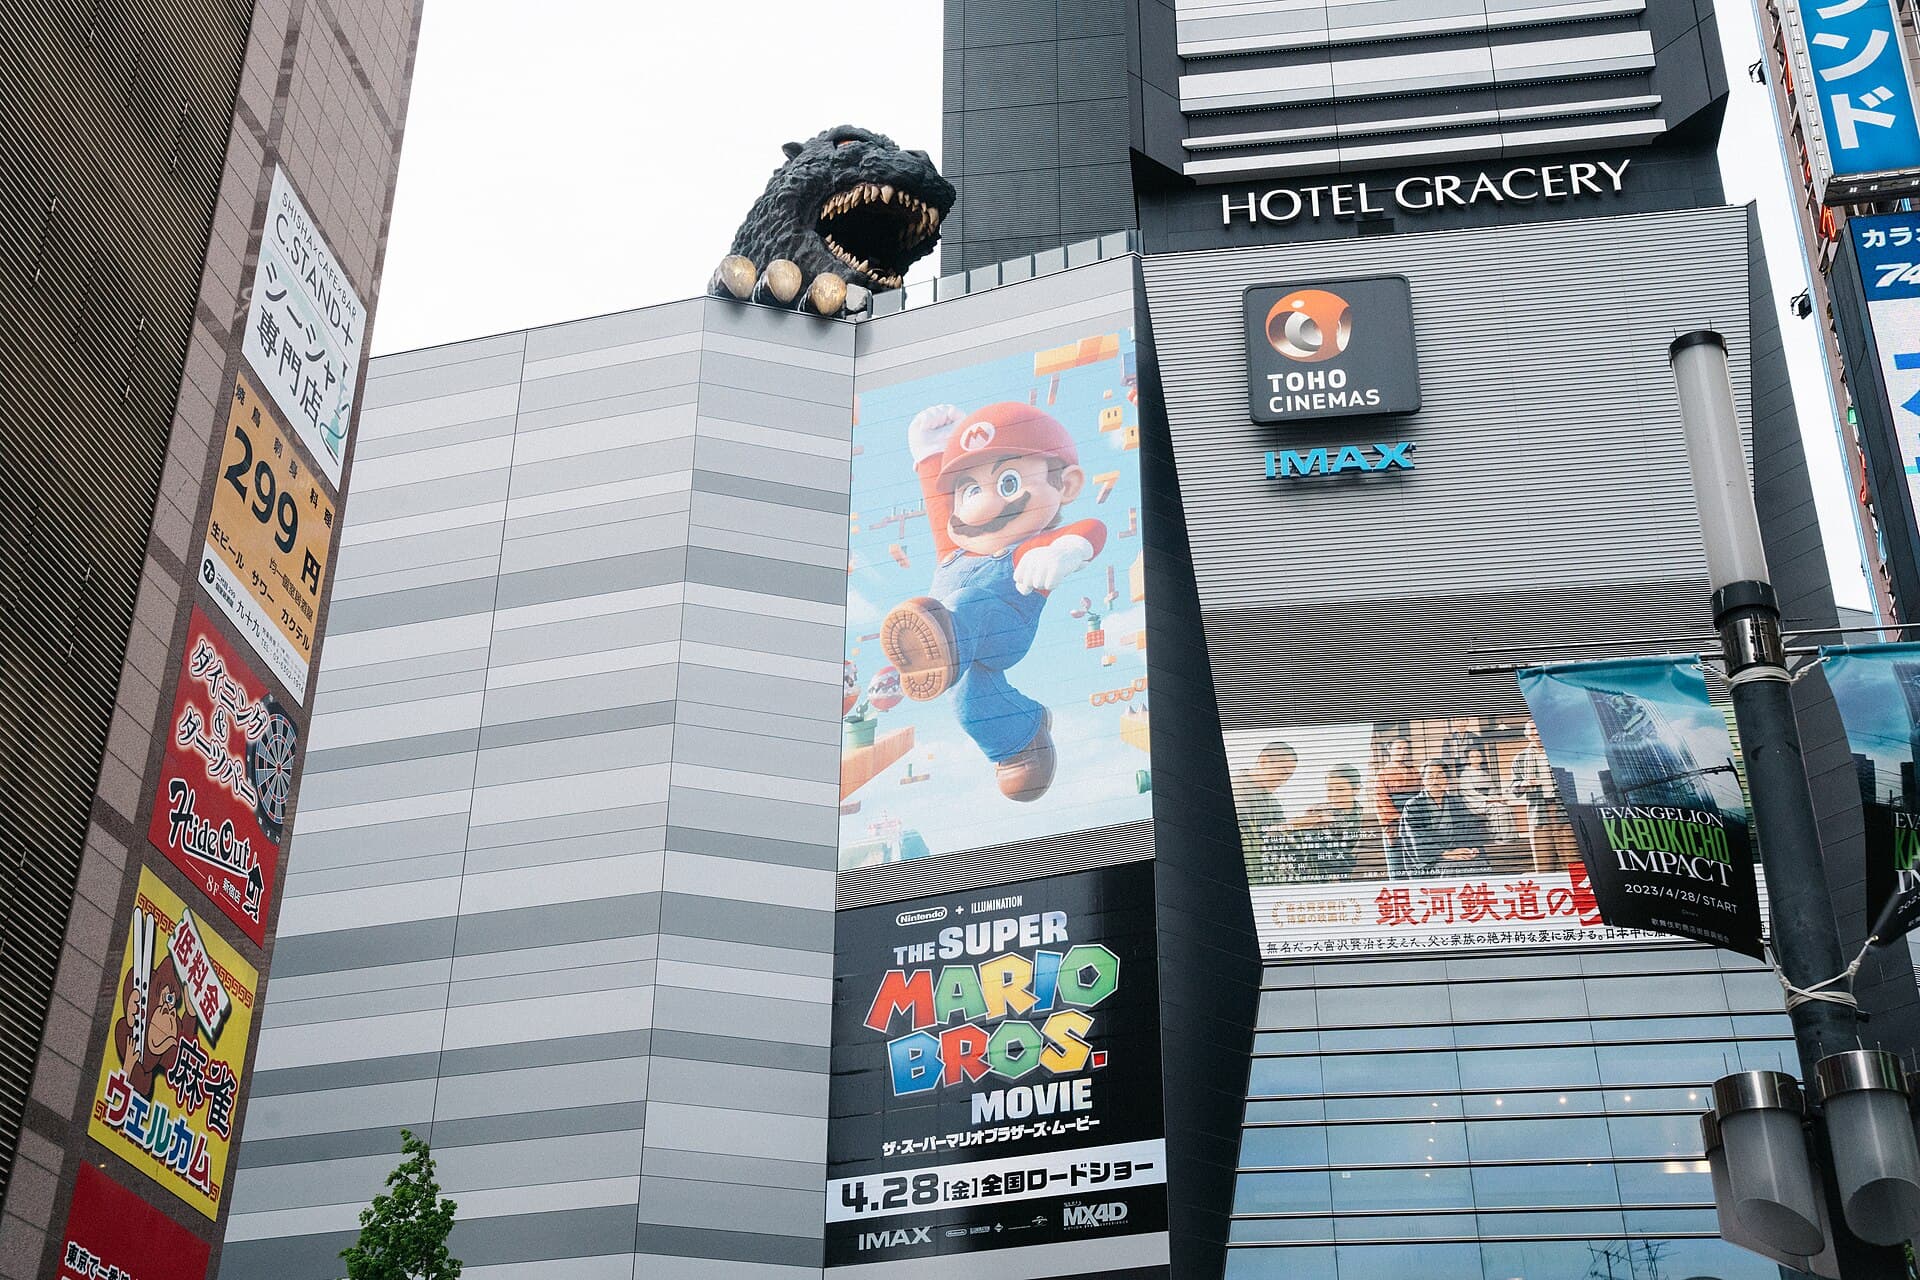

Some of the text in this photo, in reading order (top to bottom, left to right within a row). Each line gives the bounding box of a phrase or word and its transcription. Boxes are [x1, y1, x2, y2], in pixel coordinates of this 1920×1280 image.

[1222, 159, 1631, 225] HOTEL GRACERY
[1862, 226, 1920, 249] カラ
[265, 262, 335, 390] シーシャ
[256, 304, 323, 428] 専門店
[1267, 369, 1347, 393] TOHO
[1269, 389, 1380, 413] CINEMAS
[1264, 442, 1415, 479] IMAX
[210, 521, 244, 569] 生ビール
[251, 570, 275, 603] サワー
[280, 607, 310, 651] カクテル
[236, 600, 260, 637] 九十九
[190, 639, 268, 739] ダイニング
[213, 708, 227, 742] &
[177, 706, 257, 807] ダーツバー
[1599, 806, 1724, 828] EVANGELION
[1602, 818, 1731, 865] KABUKICHO
[206, 875, 220, 897] 8F
[1612, 849, 1733, 887] IMPACT
[900, 909, 945, 923] Nintendo
[971, 895, 1022, 914] ILLUMINATION
[893, 910, 1069, 966] THE SUPER
[173, 921, 220, 1026] 低料金
[863, 943, 1120, 1033] MARIO
[887, 1008, 1107, 1097] BROS.
[169, 1037, 235, 1139] 麻雀
[971, 1078, 1093, 1125] MOVIE
[882, 1116, 1100, 1157] ザ・スーパーマリオブラザーズ・ムービー
[1063, 1202, 1128, 1227] MX4D
[858, 1225, 932, 1251] IMAX
